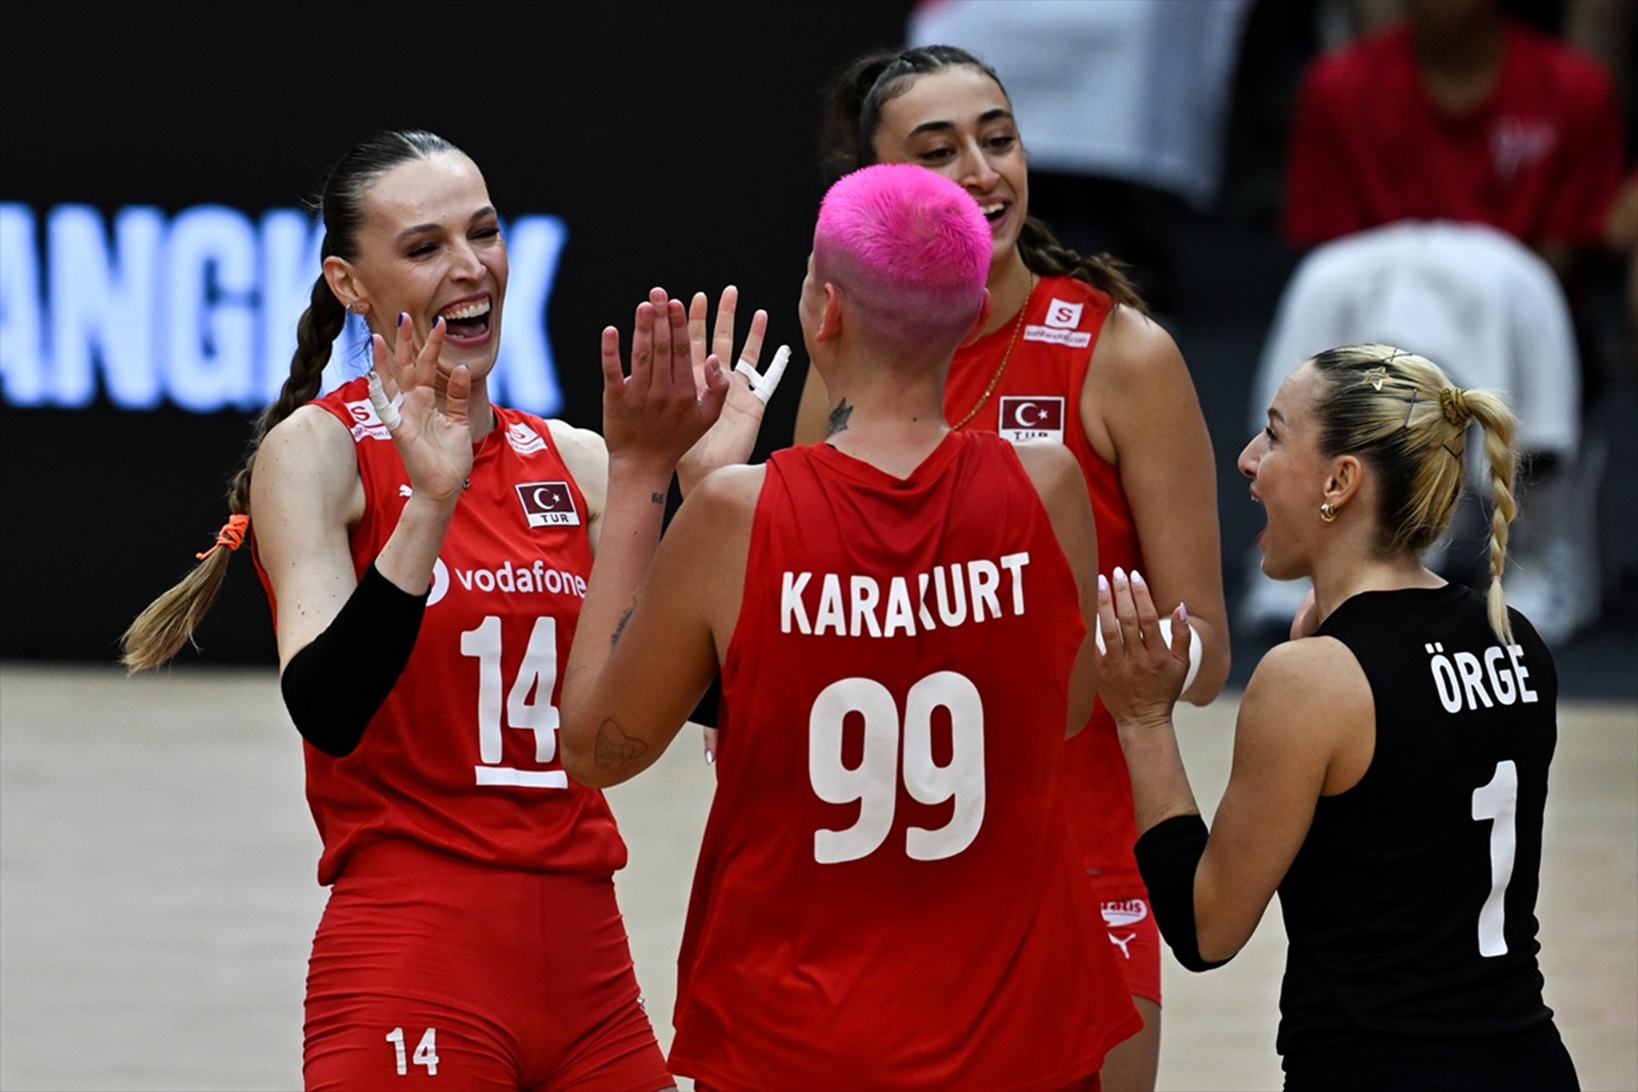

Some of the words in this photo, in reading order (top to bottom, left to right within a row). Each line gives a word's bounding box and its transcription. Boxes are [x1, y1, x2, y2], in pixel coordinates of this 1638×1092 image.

[1055, 307, 1073, 322] S
[351, 405, 370, 421] S
[541, 514, 569, 523] TUR
[455, 560, 587, 598] vodafone
[781, 552, 1030, 637] KARAKURT
[461, 615, 560, 764] 14
[1425, 642, 1538, 713] ÖRGE
[809, 670, 985, 864] 99
[1472, 760, 1517, 957] 1
[386, 1027, 439, 1075] 14
